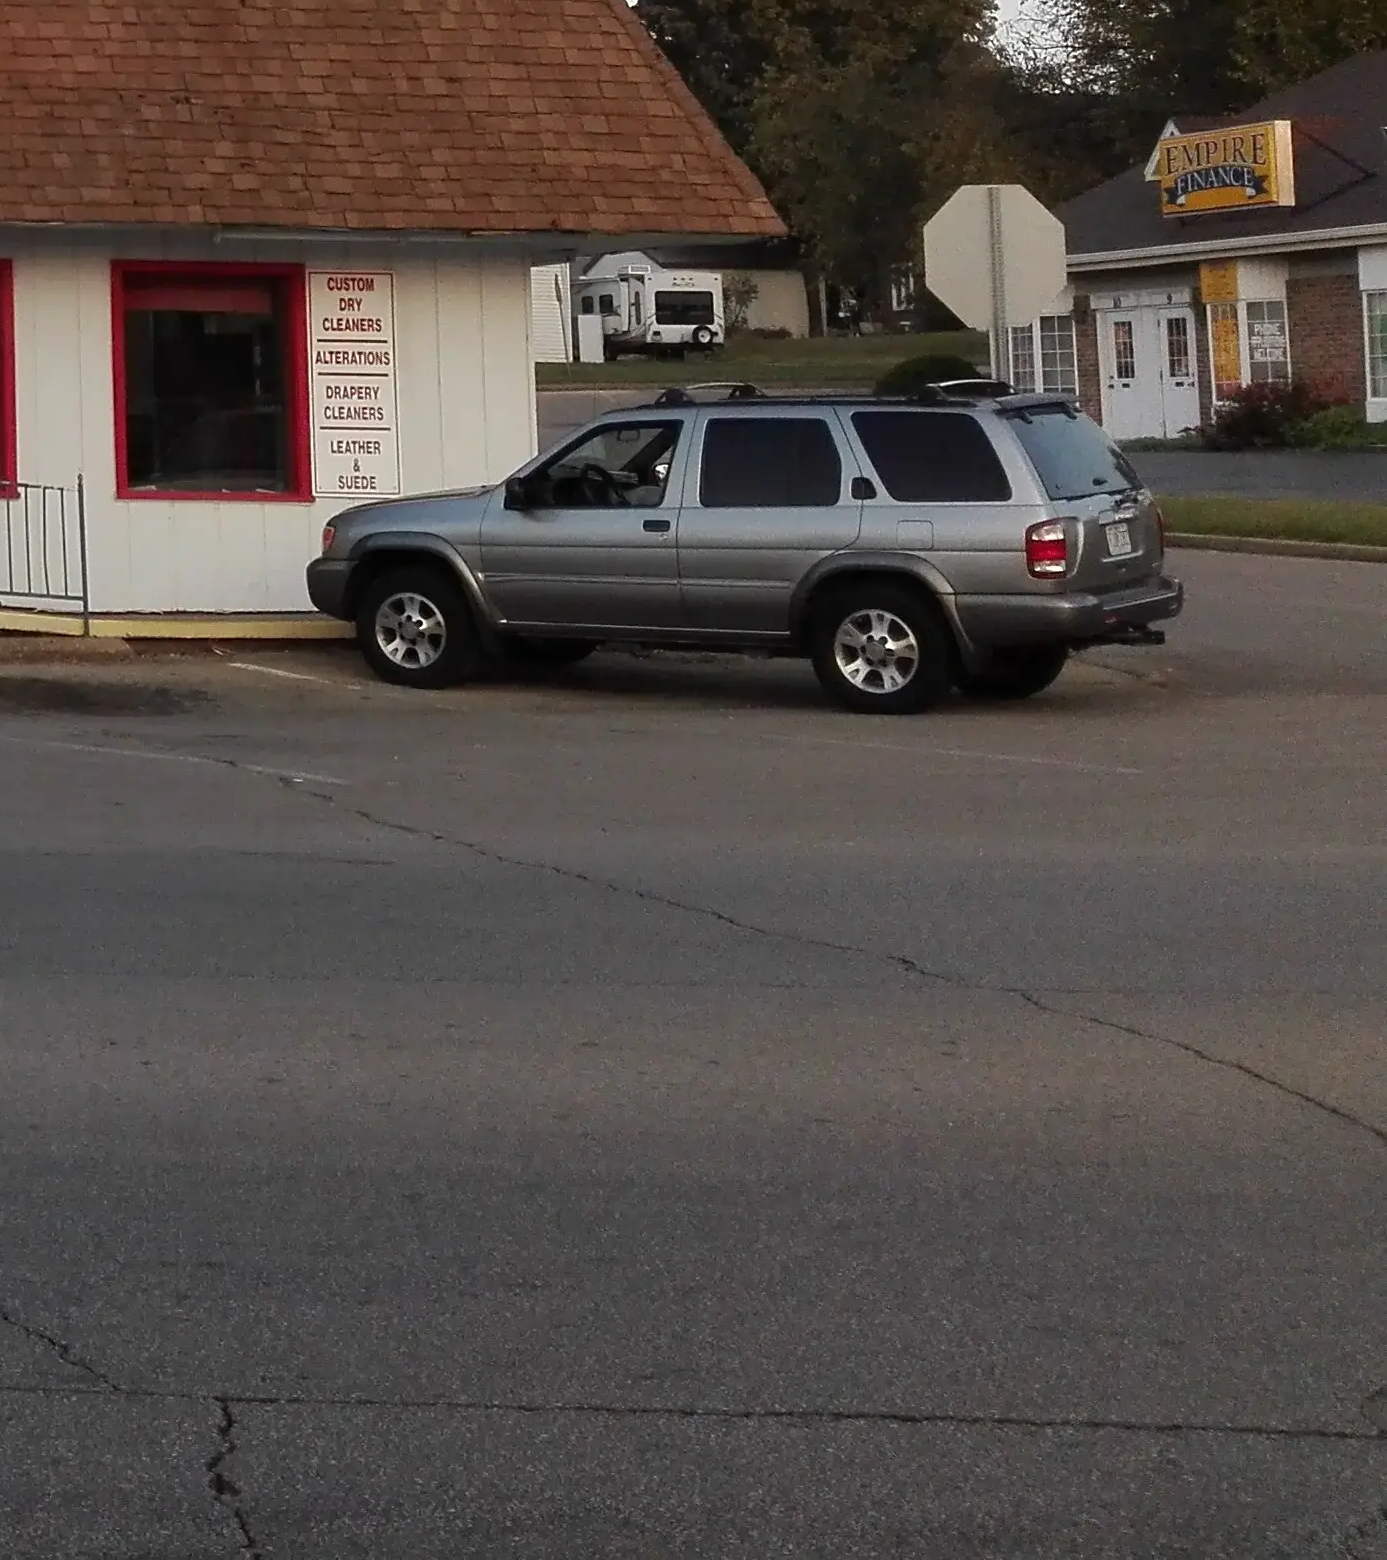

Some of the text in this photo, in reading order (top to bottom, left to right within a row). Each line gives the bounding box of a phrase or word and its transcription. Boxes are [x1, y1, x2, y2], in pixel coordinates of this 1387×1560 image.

[1165, 133, 1267, 175] EMPIRE
[1177, 167, 1255, 196] FINANCE
[327, 277, 375, 291] CUSTOM
[339, 298, 363, 312] DRY
[323, 318, 383, 332] CLEANERS
[315, 351, 391, 366] ALTERATIONS
[326, 386, 380, 400] DRAPERY
[324, 407, 384, 421] CLEANERS
[331, 441, 381, 455] LEATHER
[353, 459, 360, 472] &
[338, 475, 377, 490] SUEDE
